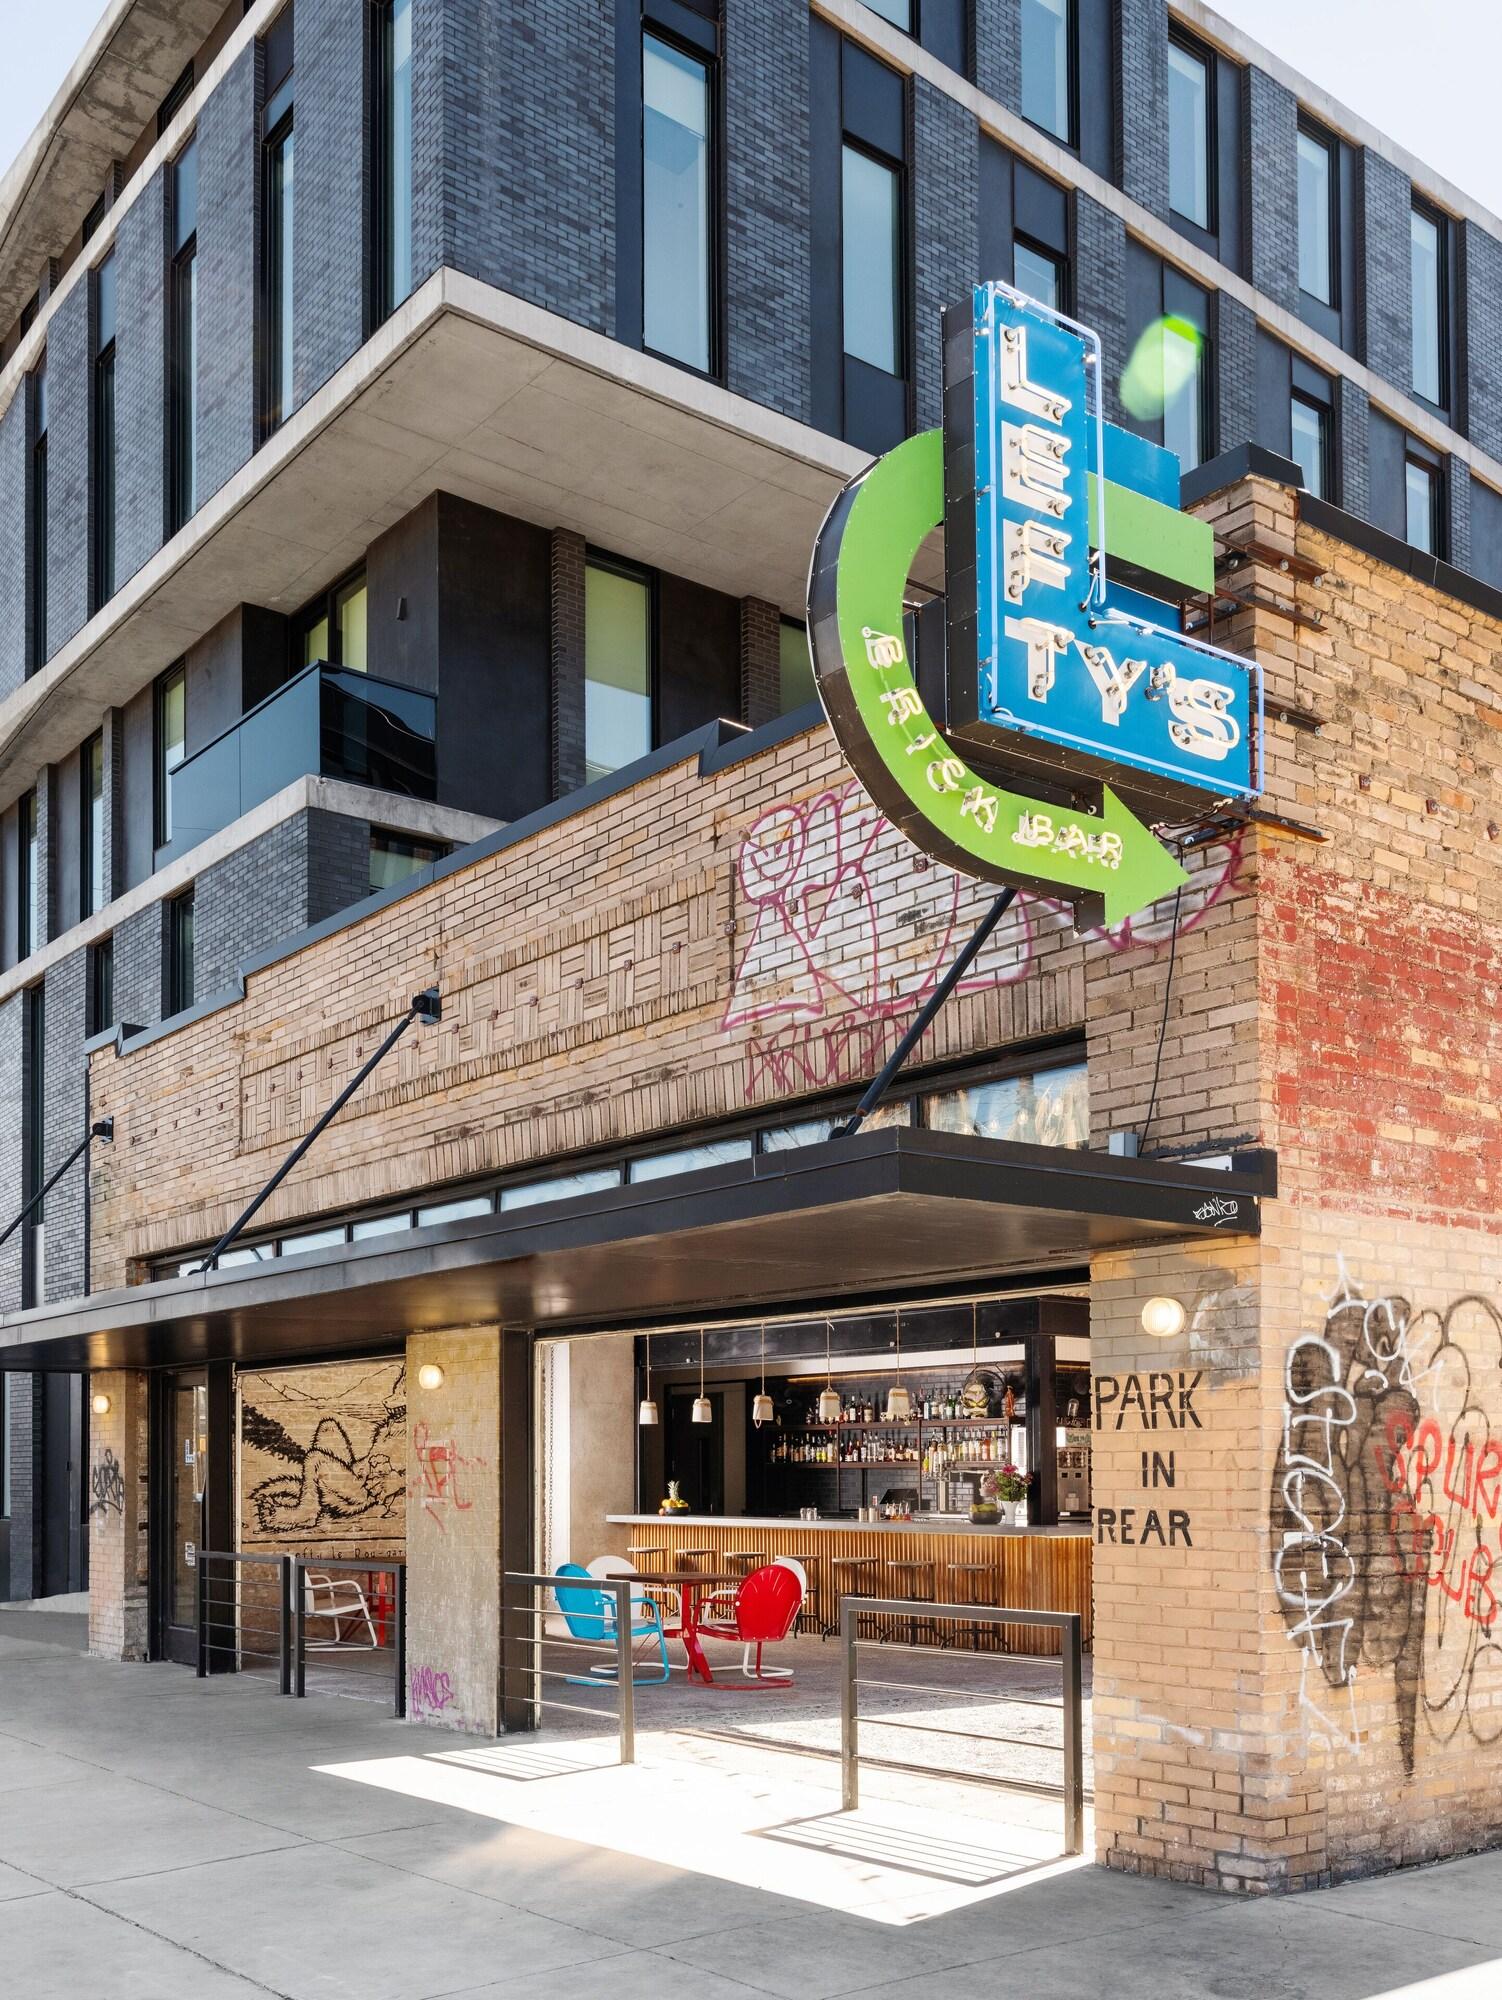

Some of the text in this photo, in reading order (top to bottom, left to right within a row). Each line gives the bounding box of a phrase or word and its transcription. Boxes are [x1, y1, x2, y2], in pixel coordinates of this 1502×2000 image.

[1012, 812, 1124, 869] BAR
[1094, 1371, 1203, 1431] PARK
[1142, 1451, 1175, 1487] IN
[1097, 1508, 1193, 1547] REAR
